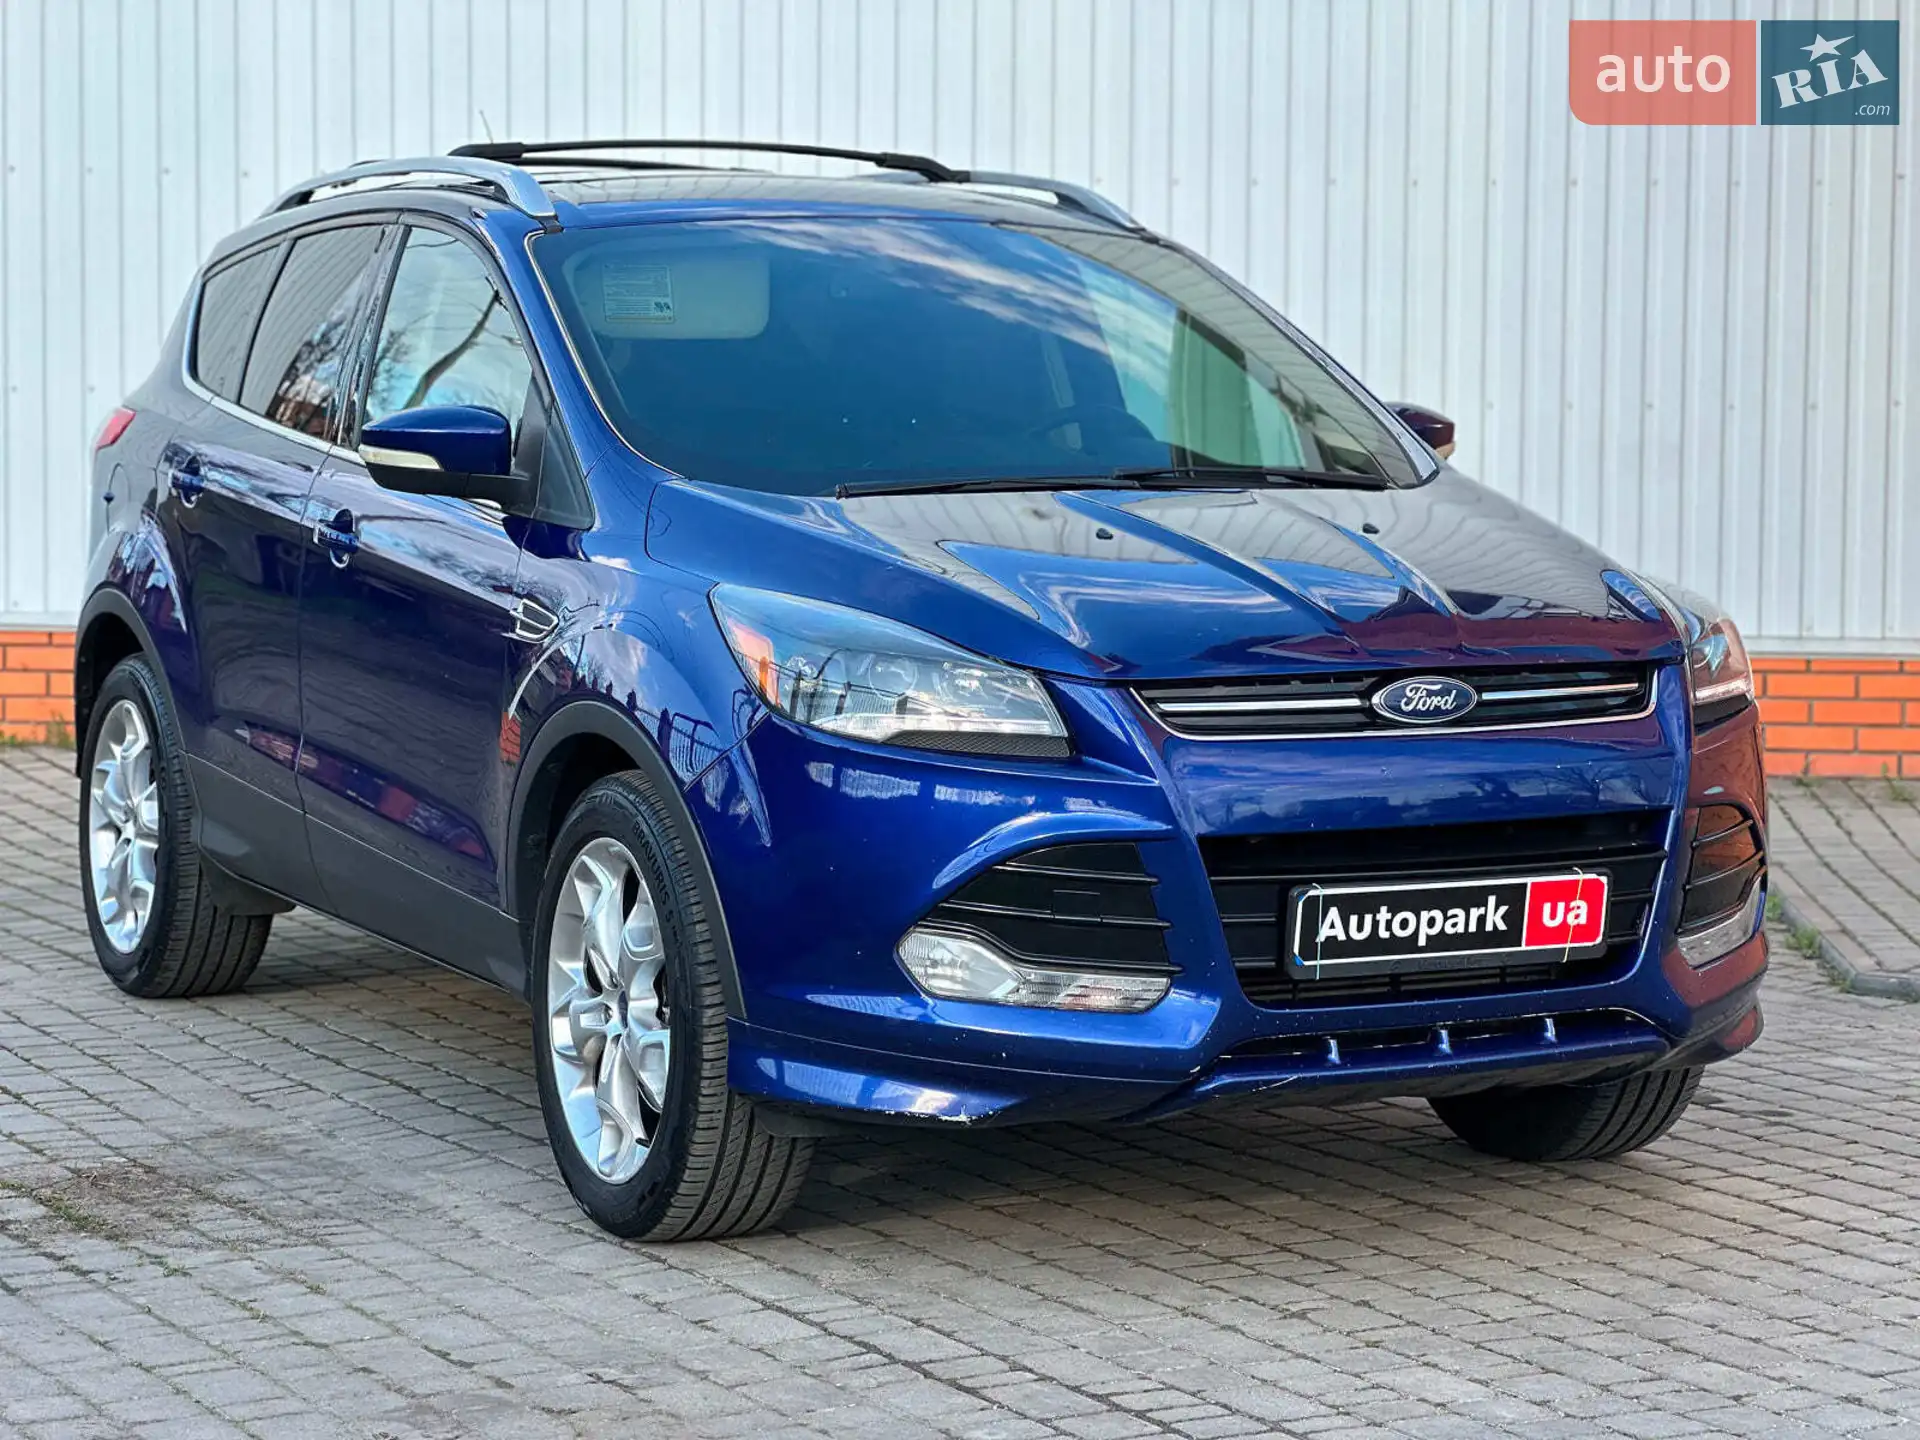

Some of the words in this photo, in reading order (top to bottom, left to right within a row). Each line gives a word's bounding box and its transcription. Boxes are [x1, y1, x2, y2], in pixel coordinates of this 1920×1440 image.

[1400, 683, 1457, 712] Ford
[631, 820, 671, 906] BRAVURIS
[1315, 895, 1509, 947] Autopark
[1542, 898, 1588, 928] ua
